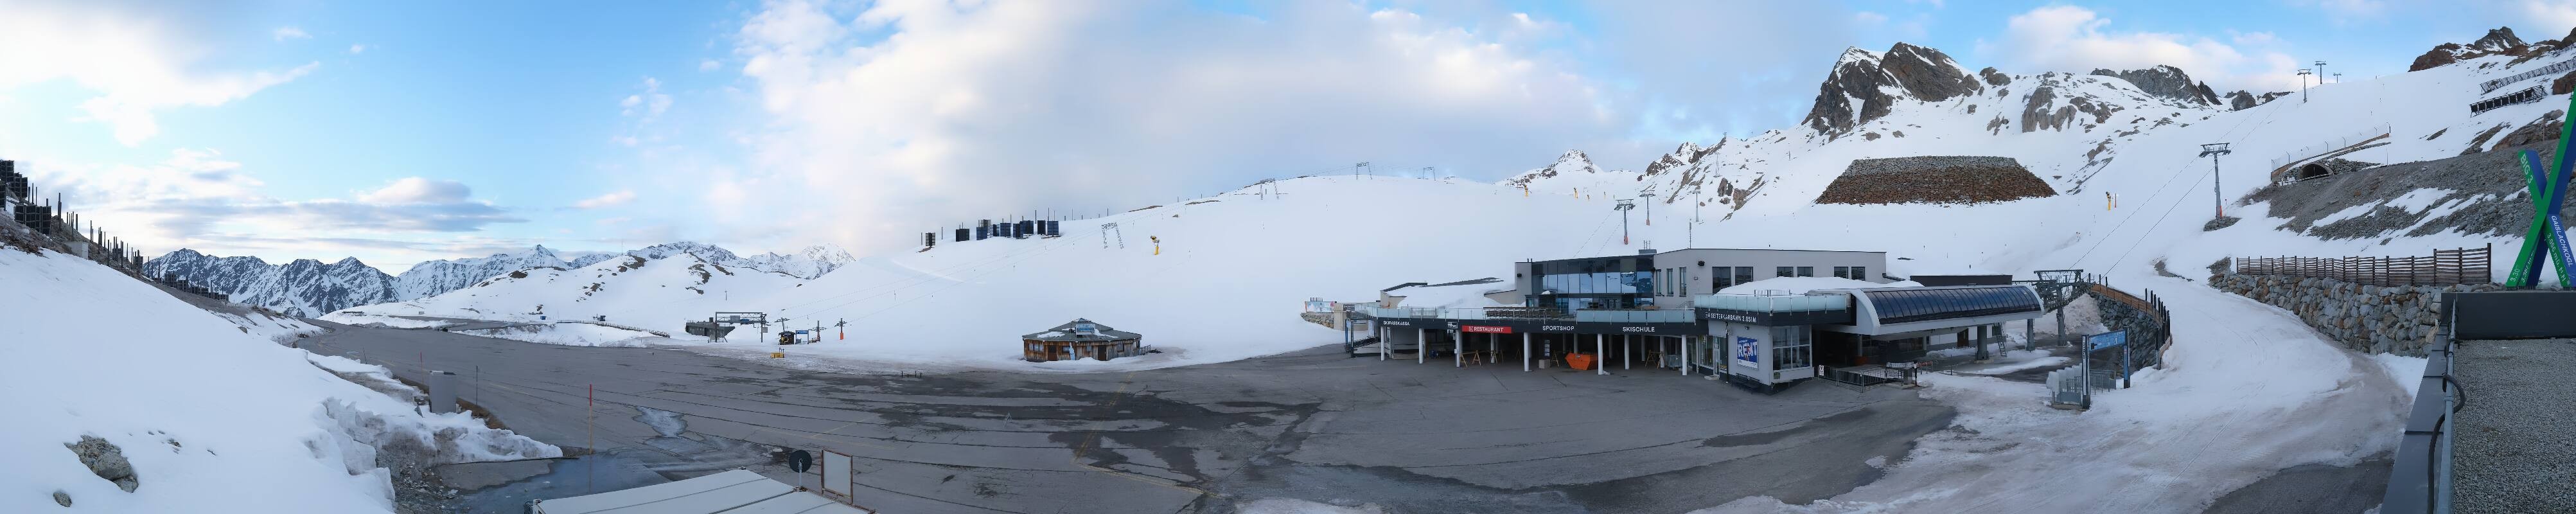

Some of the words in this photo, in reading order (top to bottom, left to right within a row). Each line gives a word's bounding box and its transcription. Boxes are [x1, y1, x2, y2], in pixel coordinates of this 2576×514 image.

[2521, 154, 2530, 175] BIG
[2528, 175, 2533, 184] 3
[2551, 215, 2573, 267] GAISLACHKOGL
[1737, 341, 1758, 357] RENT
